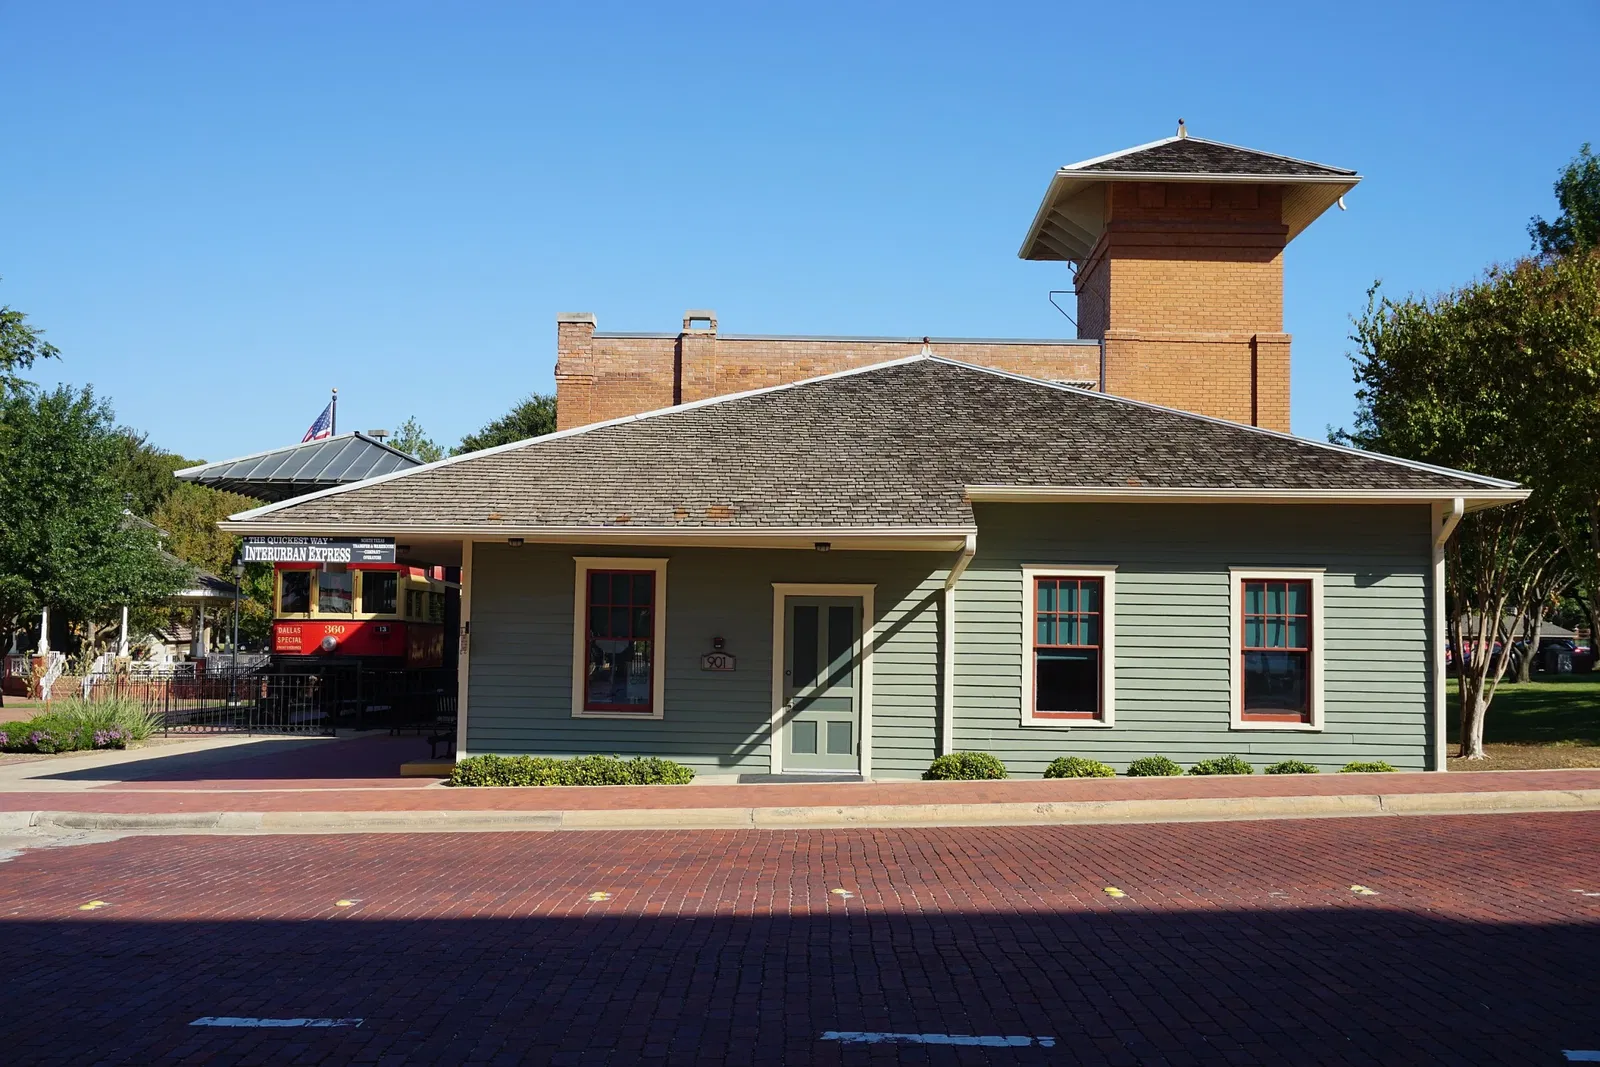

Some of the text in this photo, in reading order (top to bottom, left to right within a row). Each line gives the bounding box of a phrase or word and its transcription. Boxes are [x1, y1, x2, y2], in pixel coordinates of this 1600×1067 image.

[267, 537, 309, 545] QUICKEST
[245, 545, 351, 562] INTERURBAN EXPRESS
[324, 624, 345, 634] 360
[707, 656, 726, 668] 901
